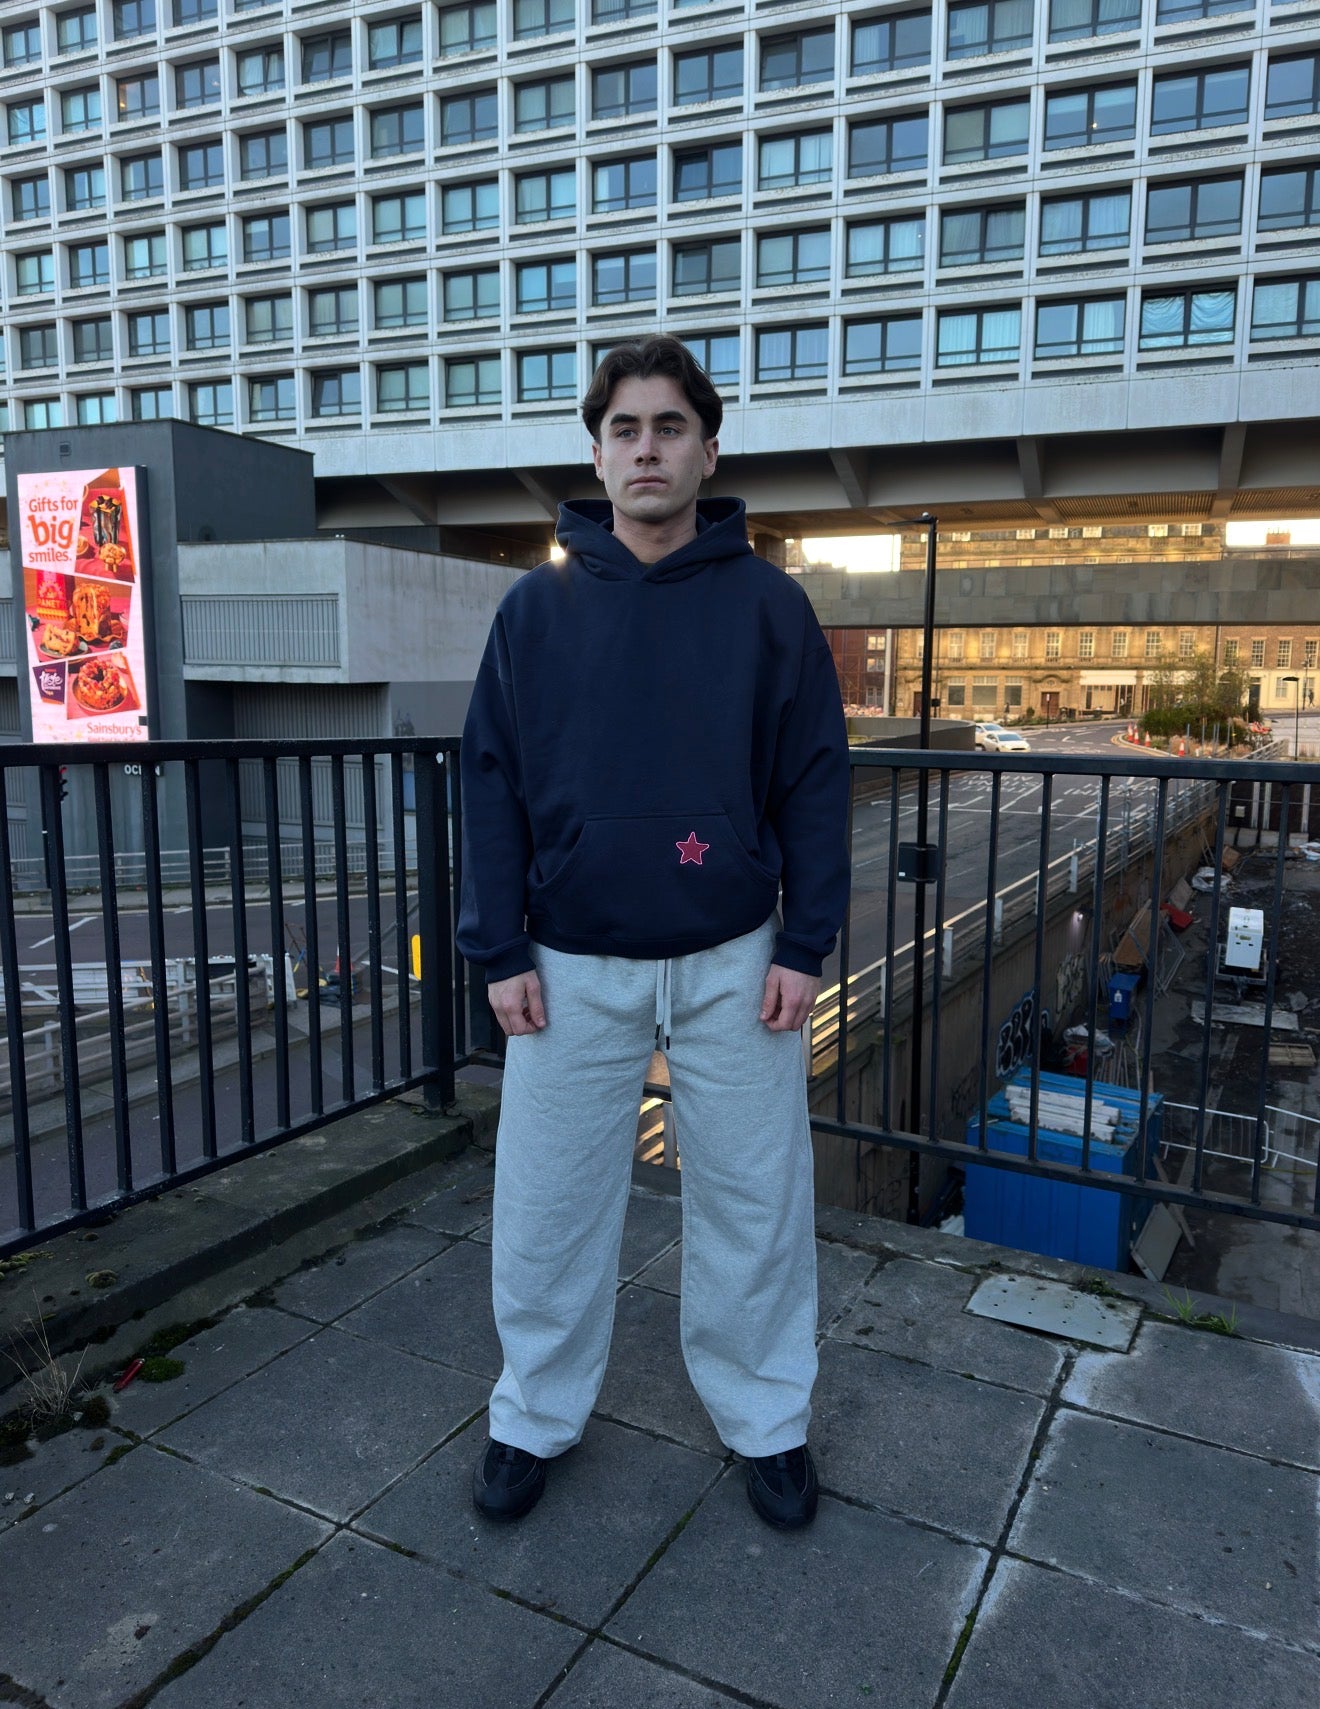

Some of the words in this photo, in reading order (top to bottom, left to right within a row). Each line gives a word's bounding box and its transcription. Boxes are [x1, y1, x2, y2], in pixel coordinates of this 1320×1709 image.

[29, 497, 59, 512] Gifts
[61, 496, 78, 510] for
[28, 515, 74, 549] big
[28, 548, 72, 562] smiles.
[87, 722, 142, 737] Sainsbury's
[124, 764, 160, 776] OCN
